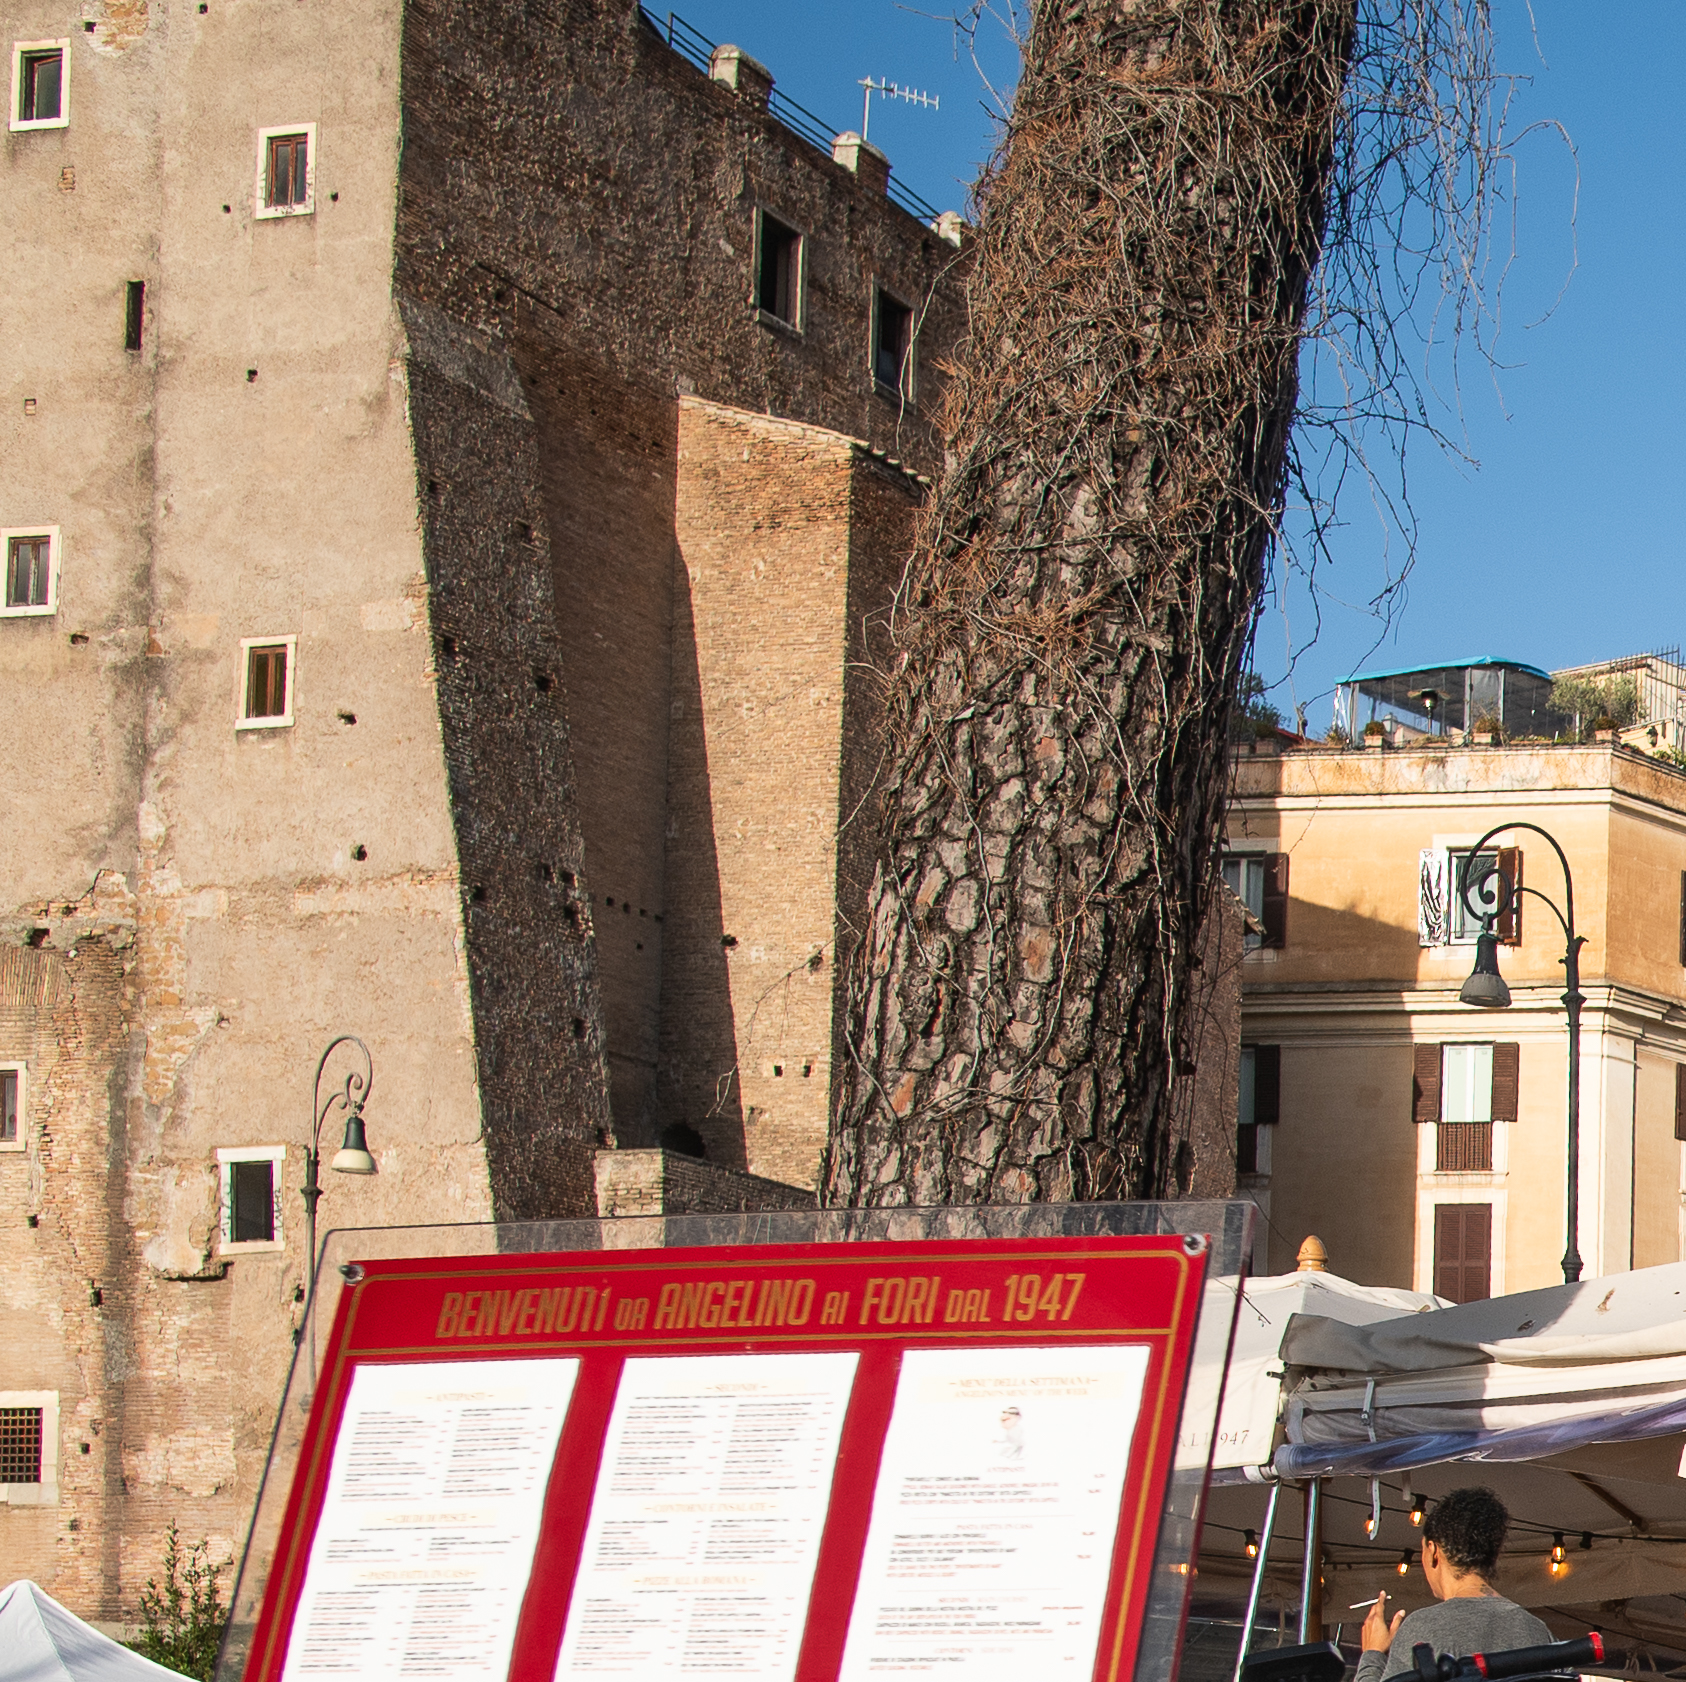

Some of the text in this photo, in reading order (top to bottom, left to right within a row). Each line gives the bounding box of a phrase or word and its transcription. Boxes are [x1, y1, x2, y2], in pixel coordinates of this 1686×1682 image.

[612, 1298, 650, 1331] DA
[653, 1279, 817, 1330] ANGELINO
[820, 1291, 850, 1325] AI
[858, 1276, 941, 1325] FORI
[943, 1289, 992, 1323] DAL
[1002, 1273, 1086, 1322] 1947
